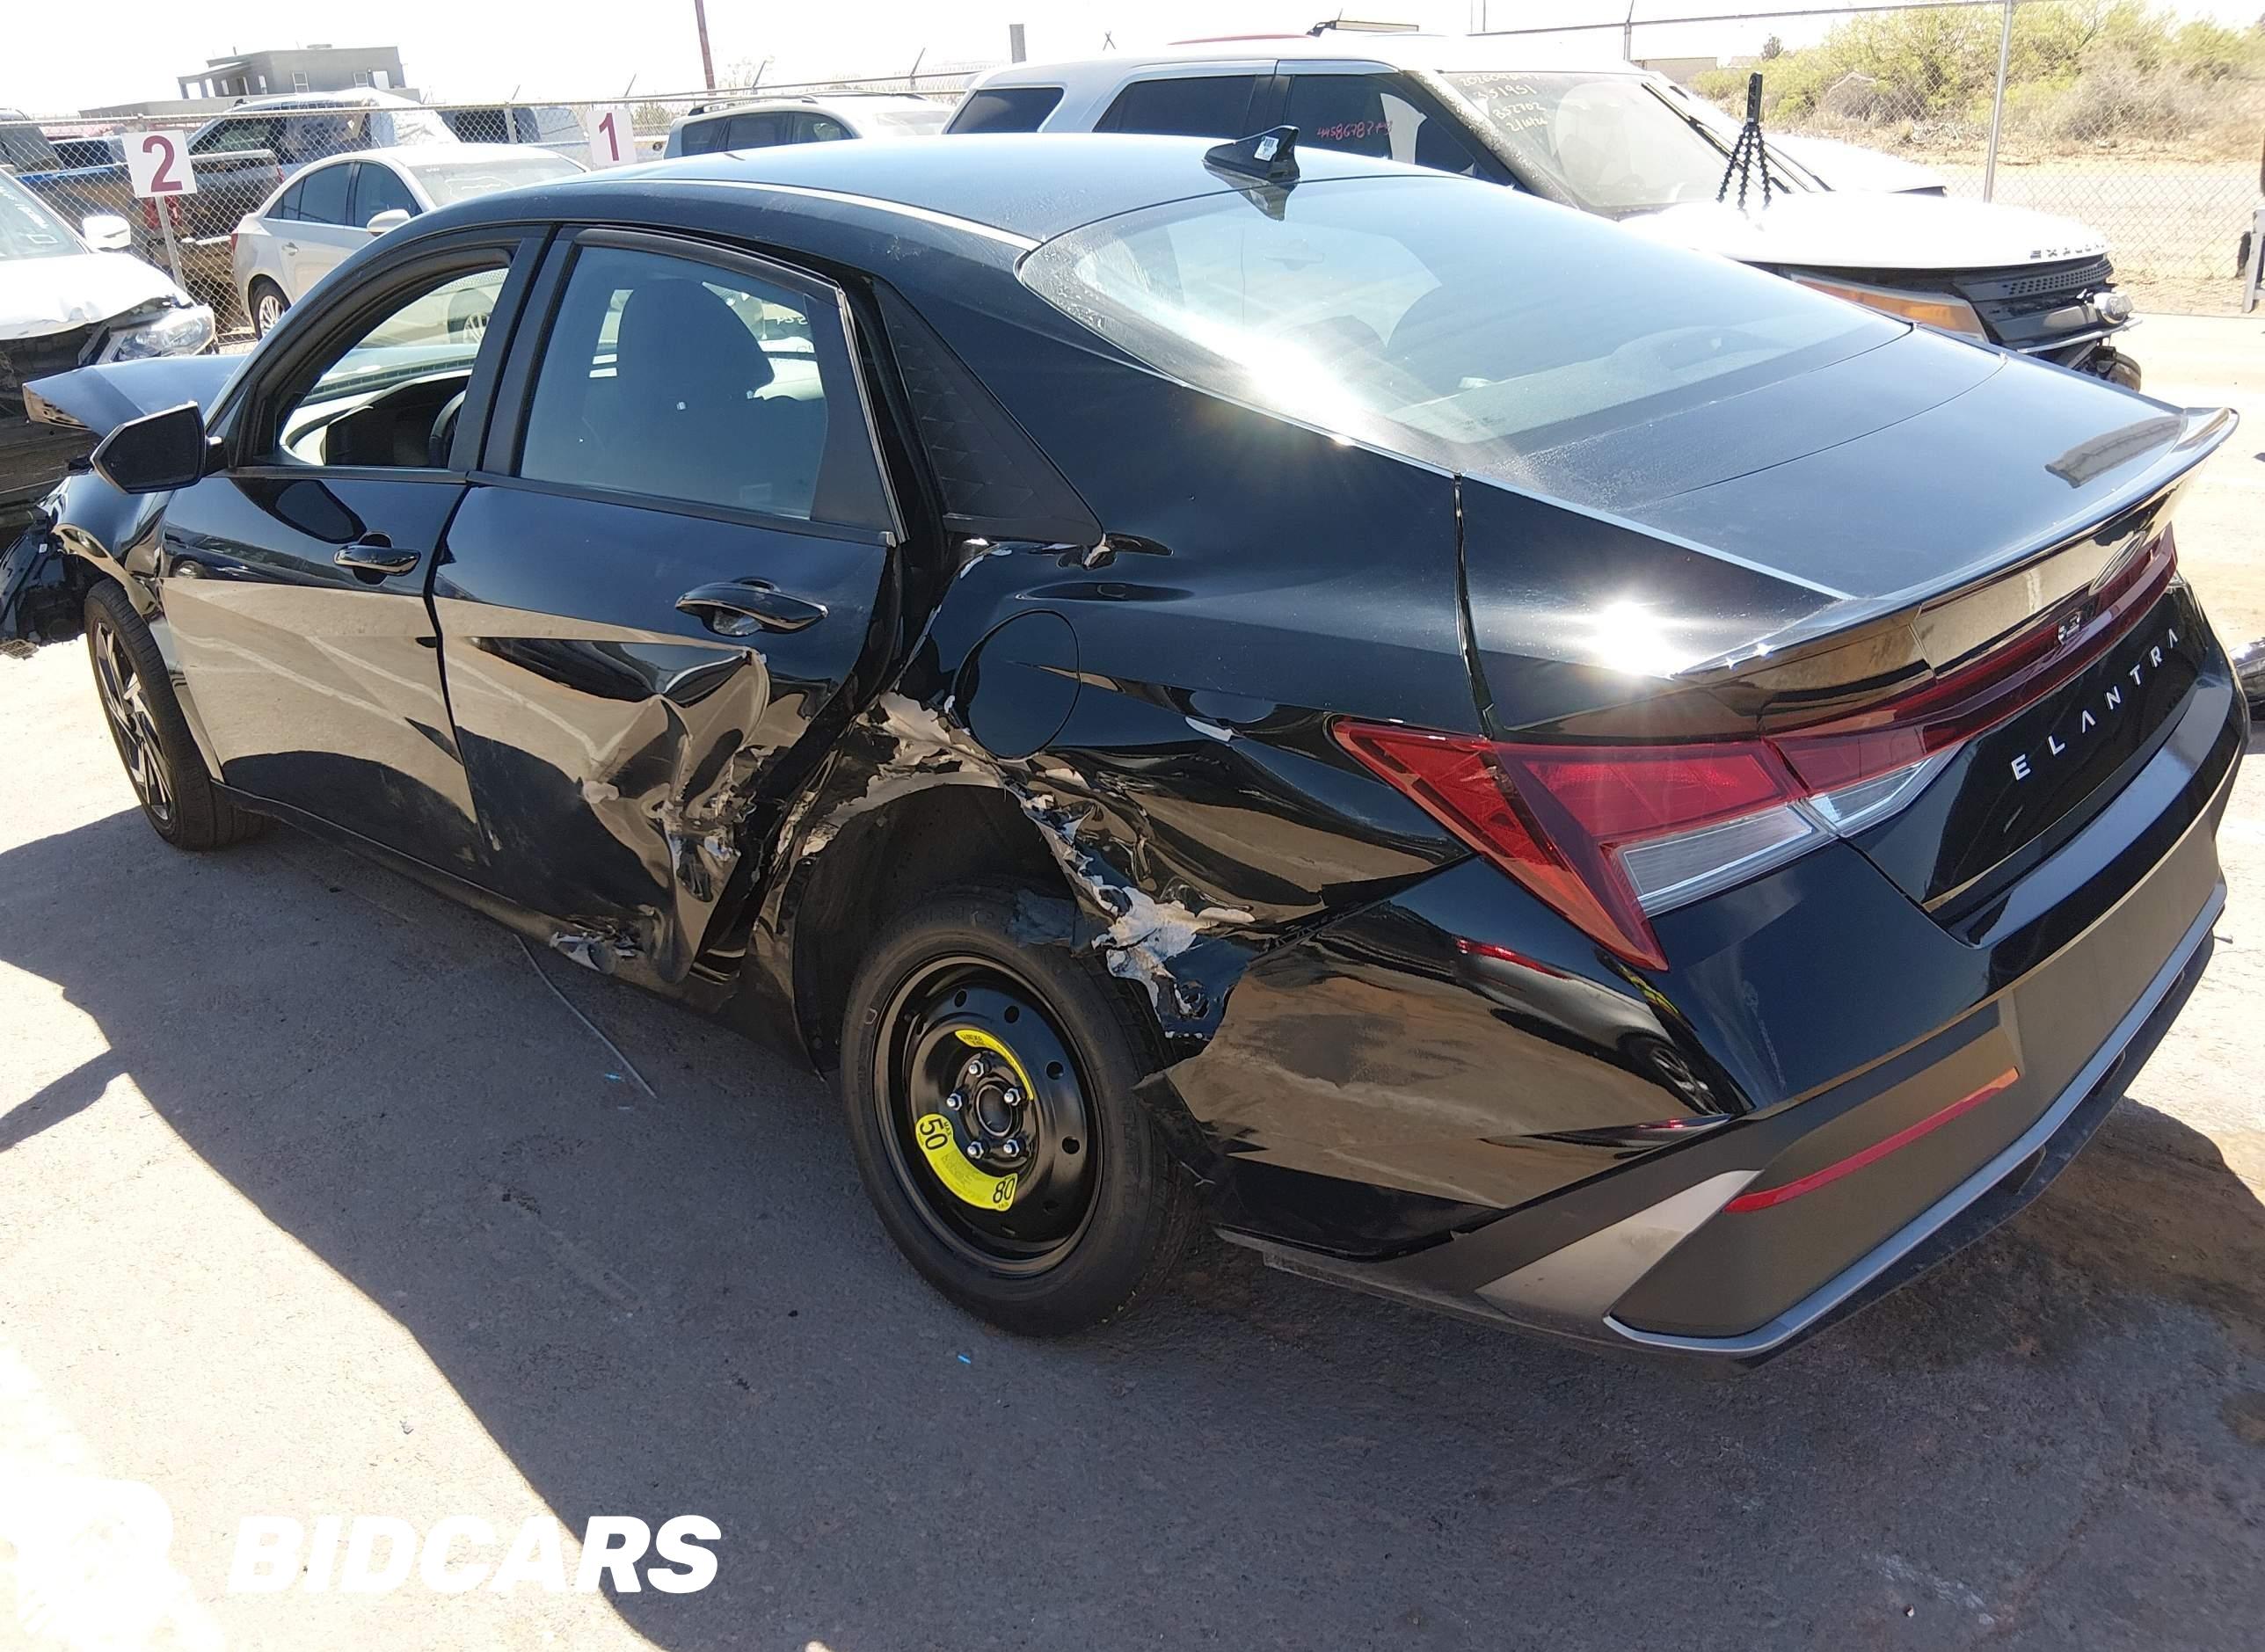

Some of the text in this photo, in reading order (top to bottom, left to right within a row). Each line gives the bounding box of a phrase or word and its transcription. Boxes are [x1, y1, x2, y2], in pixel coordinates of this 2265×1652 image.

[599, 113, 619, 161] 1
[142, 135, 183, 193] 2
[2011, 628, 2178, 782] ELANTRA
[919, 1118, 948, 1150] 50
[993, 1177, 1016, 1203] 80
